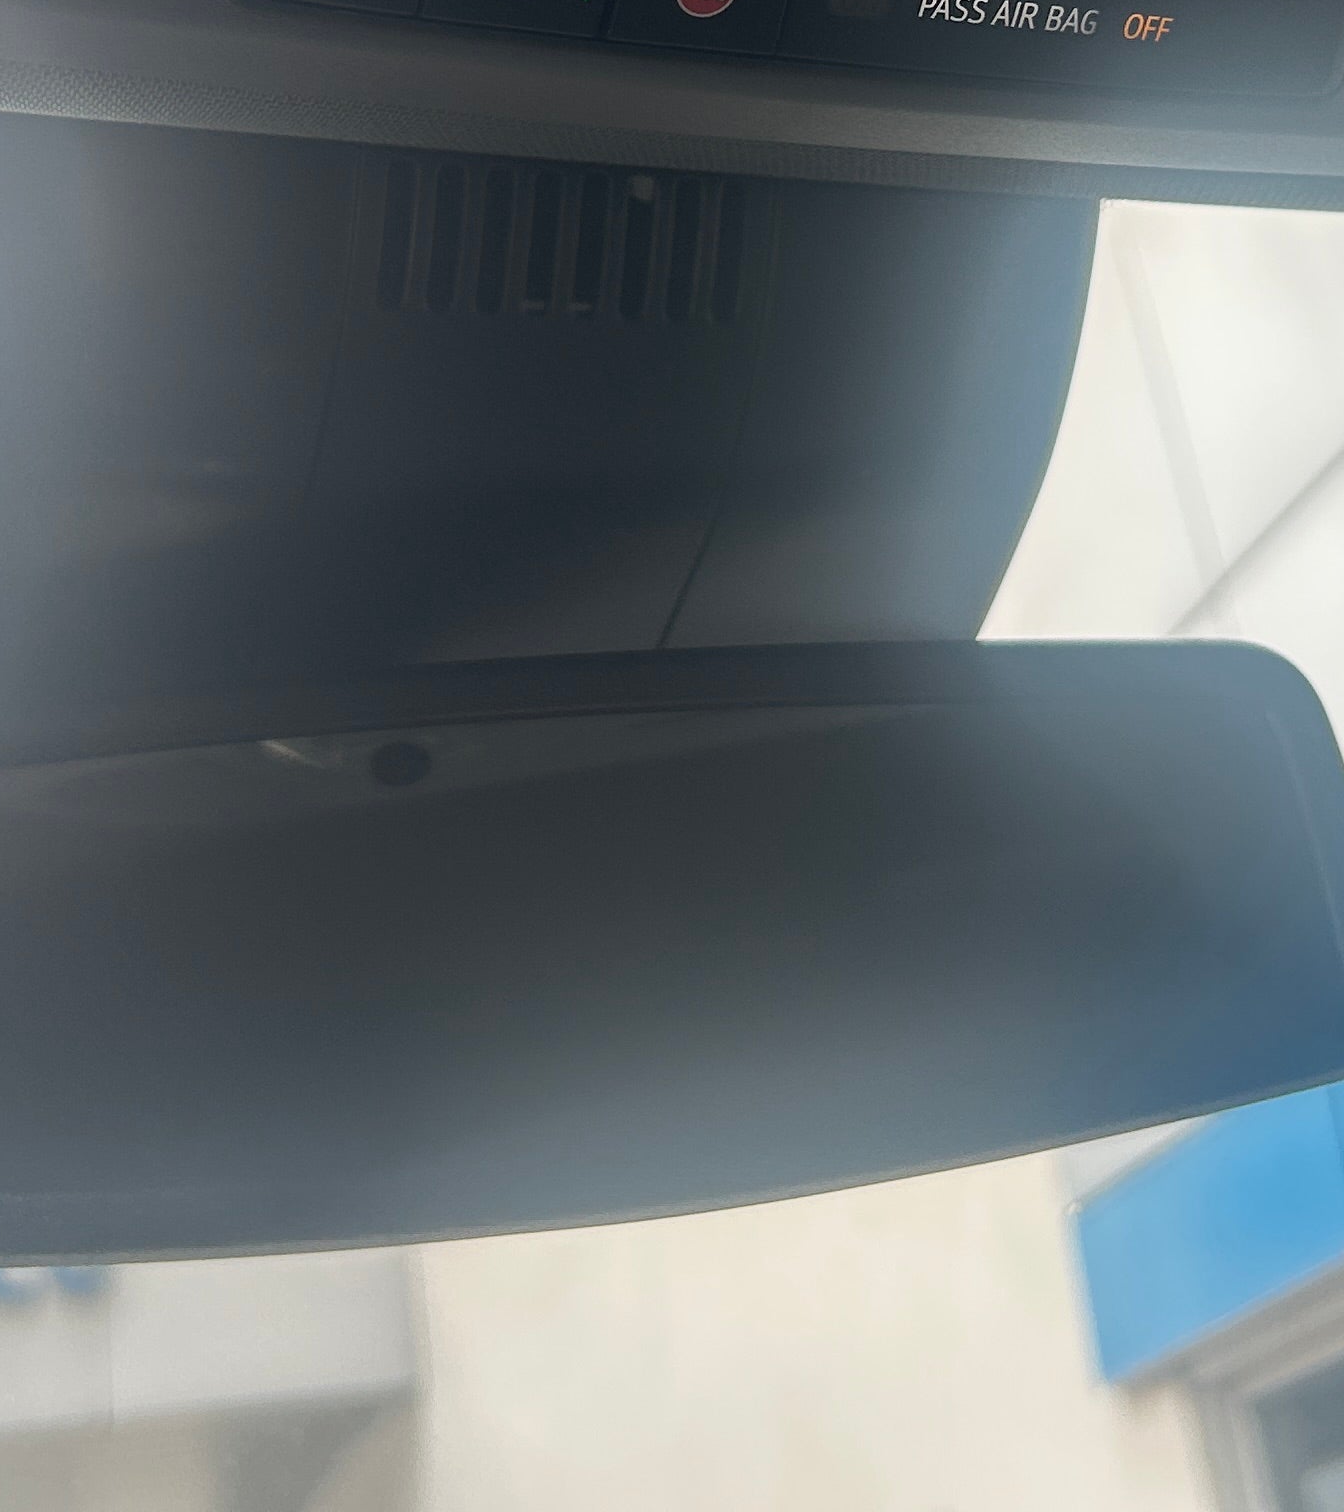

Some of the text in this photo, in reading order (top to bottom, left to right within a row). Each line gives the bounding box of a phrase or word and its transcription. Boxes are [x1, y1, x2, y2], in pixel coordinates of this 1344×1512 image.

[990, 0, 1039, 30] AIR
[1044, 6, 1099, 36] BAG
[1122, 13, 1174, 42] OFF
